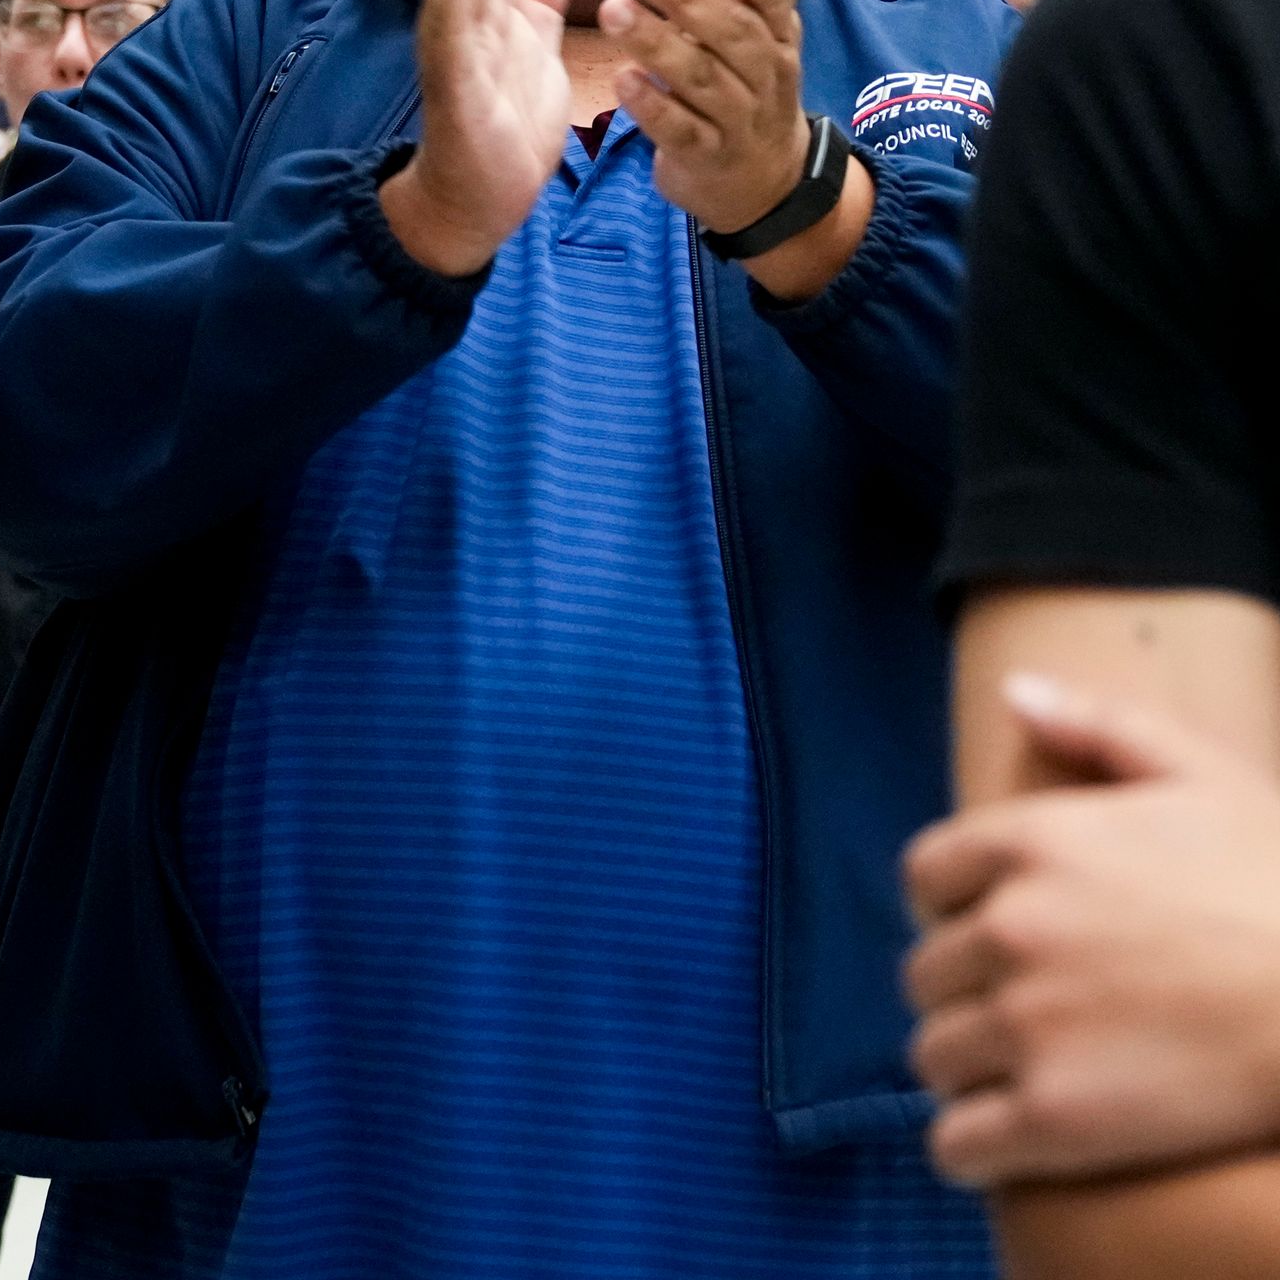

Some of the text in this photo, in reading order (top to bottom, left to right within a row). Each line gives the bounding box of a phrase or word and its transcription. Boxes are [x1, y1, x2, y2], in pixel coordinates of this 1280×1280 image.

[854, 73, 995, 119] SPEEA
[856, 107, 900, 137] IFPTE
[906, 99, 963, 115] LOCAL
[875, 125, 957, 155] COUNCIL
